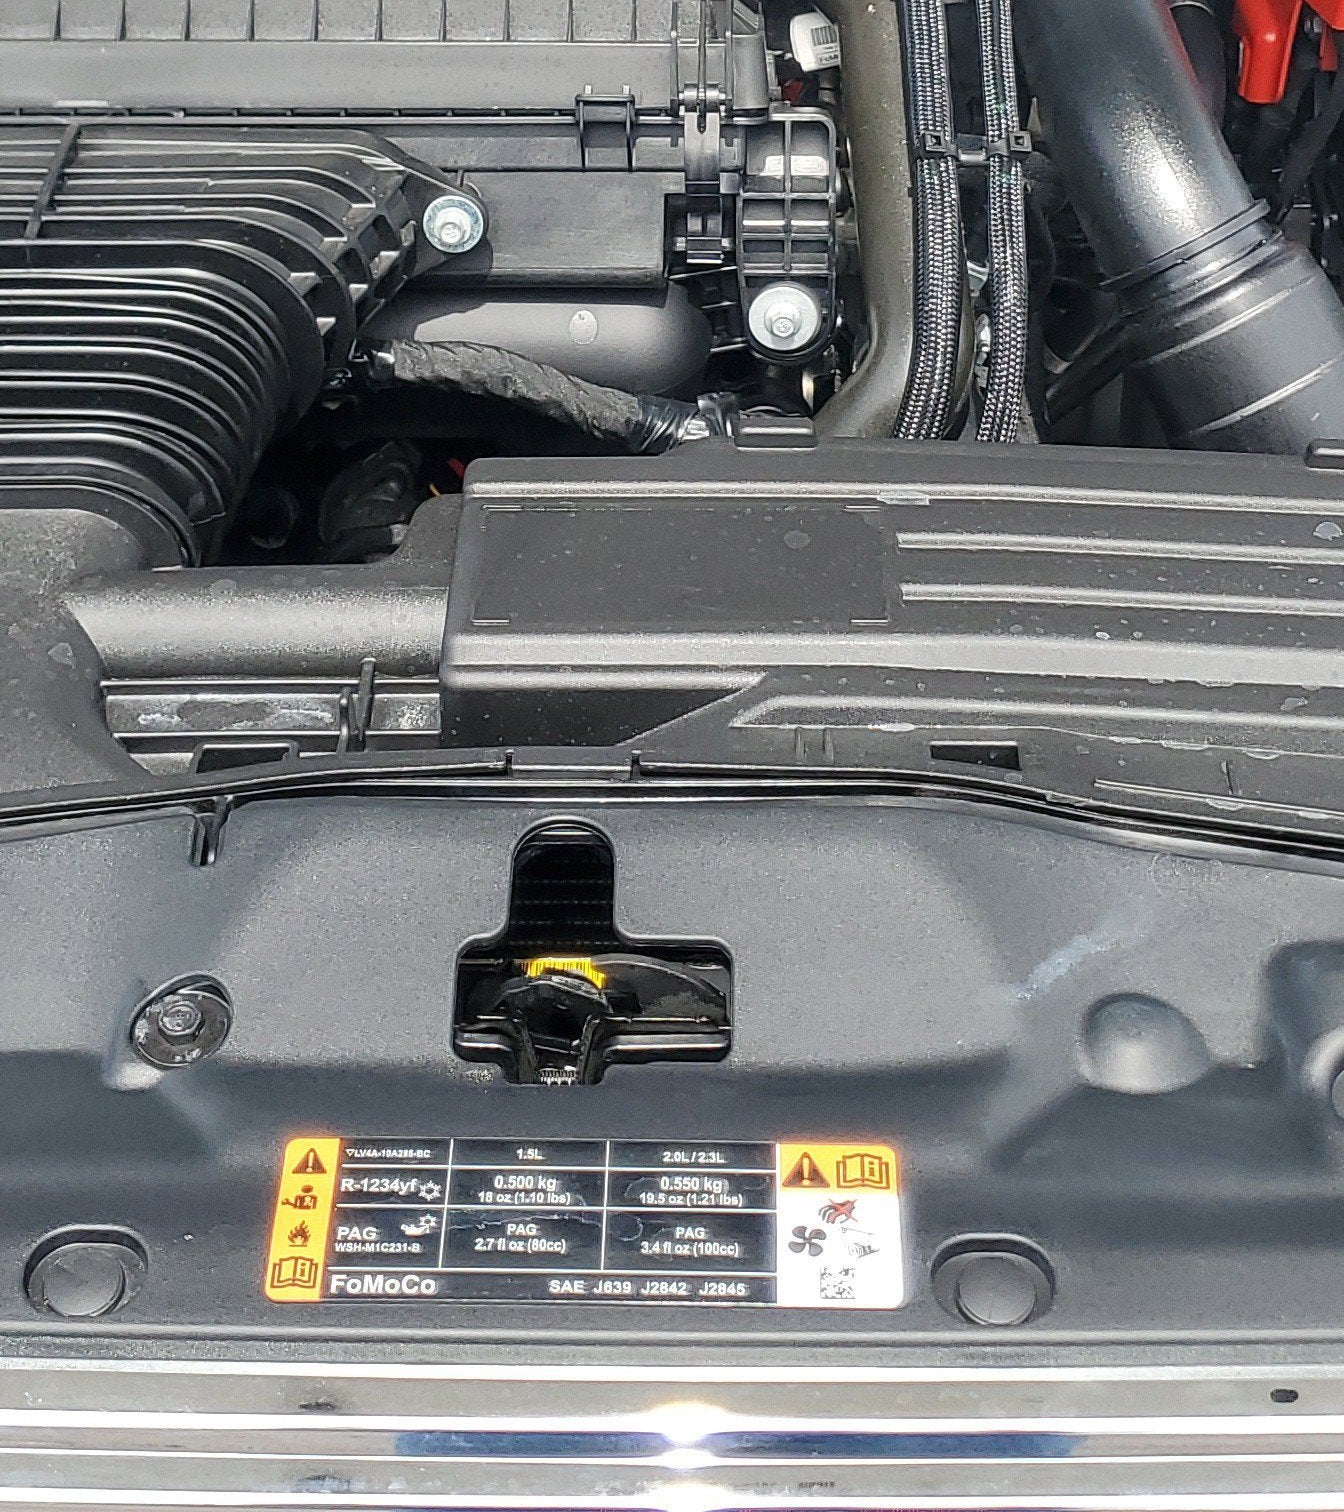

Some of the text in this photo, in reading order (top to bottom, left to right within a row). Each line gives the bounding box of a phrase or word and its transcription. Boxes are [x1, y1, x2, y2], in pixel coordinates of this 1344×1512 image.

[517, 1148, 543, 1160] 1.5L
[663, 1151, 690, 1163] 2.0L
[698, 1152, 725, 1164] 2.3L
[341, 1178, 419, 1196] R-1234yf
[494, 1175, 557, 1192] 0.500 kg
[660, 1176, 723, 1194] 0.550 kg
[478, 1191, 572, 1206] 18 oz (1.10 lbs)
[639, 1191, 743, 1207] 19.5 oz (1.21 lbs)
[337, 1226, 377, 1240] PAG
[507, 1223, 537, 1236] PAG
[675, 1227, 706, 1239] PAG
[474, 1237, 495, 1251] 2.7
[508, 1240, 525, 1252] oz
[527, 1238, 566, 1254] (80cc)
[640, 1241, 661, 1254] 3.4
[674, 1244, 690, 1255] oz
[693, 1242, 739, 1257] (100cc)
[330, 1274, 437, 1295] FoMoCo
[549, 1280, 746, 1296] SAE J639 J2842 J2845
